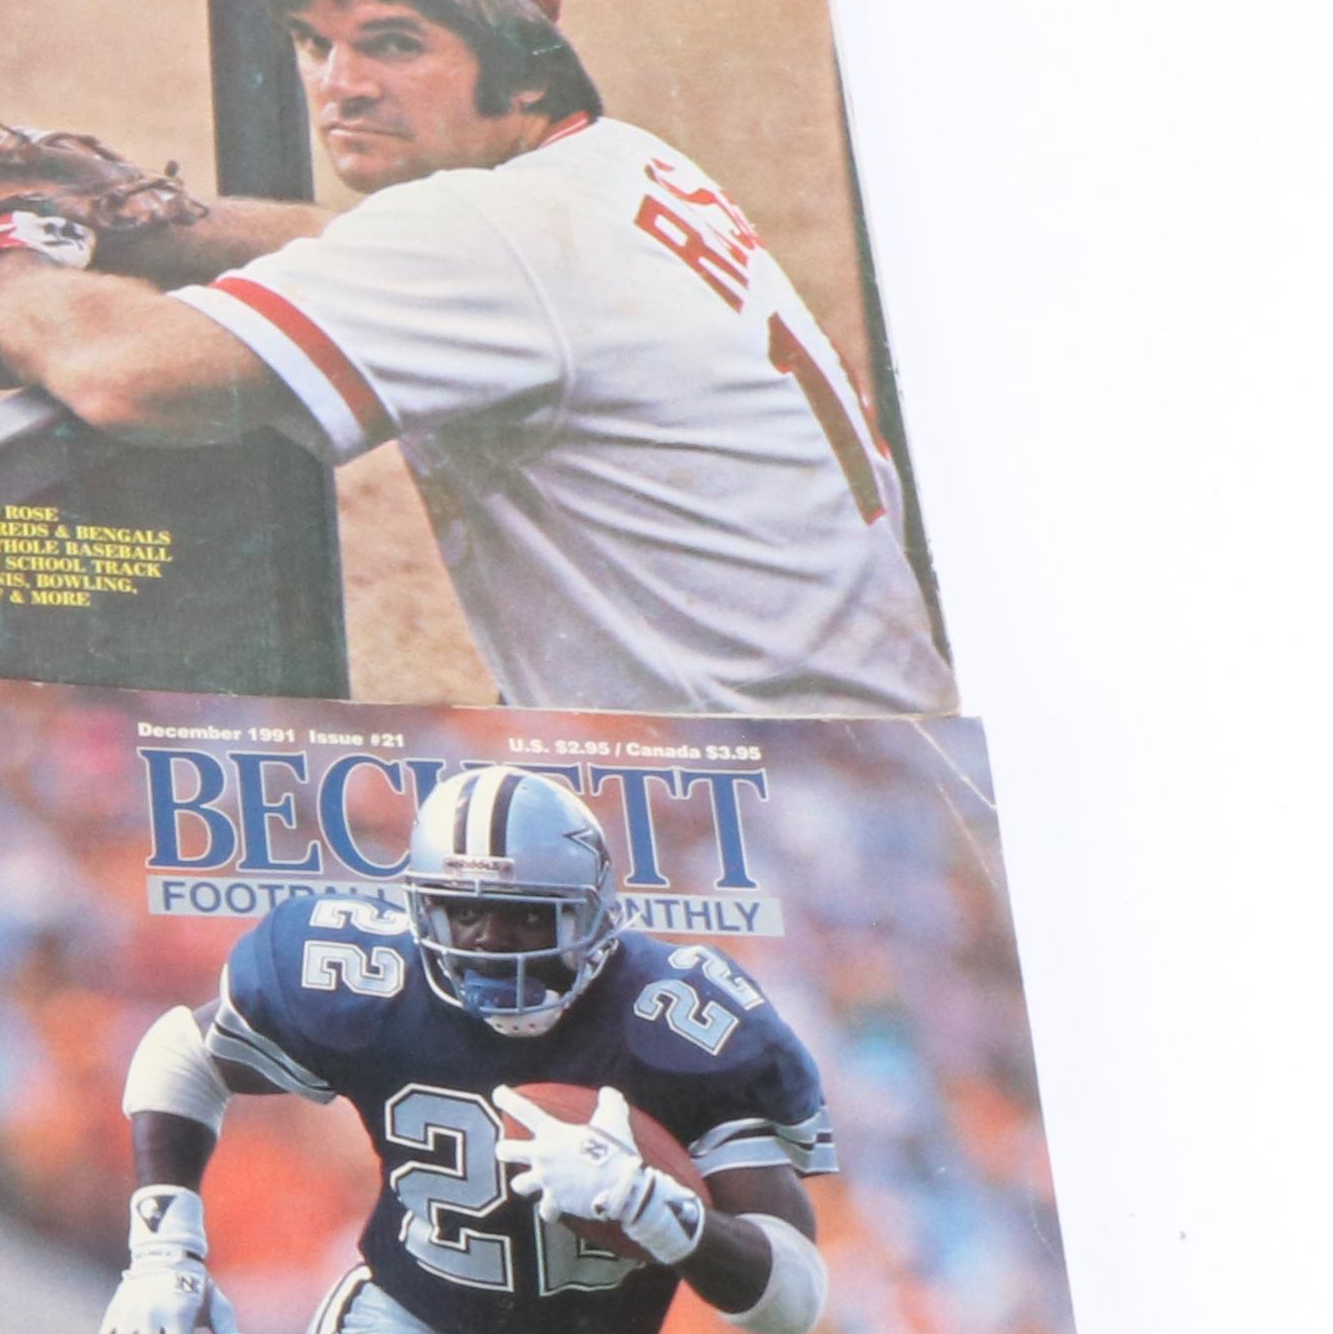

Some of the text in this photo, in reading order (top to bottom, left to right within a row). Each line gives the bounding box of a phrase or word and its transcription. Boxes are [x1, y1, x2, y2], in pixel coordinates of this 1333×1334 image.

[4, 504, 59, 522] ROSE
[54, 524, 71, 539] &
[75, 525, 172, 545] BENGALS
[65, 541, 173, 562] BASEBALL
[4, 555, 87, 573] SCHOOL
[90, 558, 163, 578] TRACK
[36, 572, 138, 594] BOWLING,
[9, 588, 25, 604] &
[30, 589, 91, 607] MORE
[137, 721, 405, 748] December 1991 Issue #21
[508, 737, 762, 761] U.S. $2.95 Canada $3.95
[136, 746, 769, 890] BECTT
